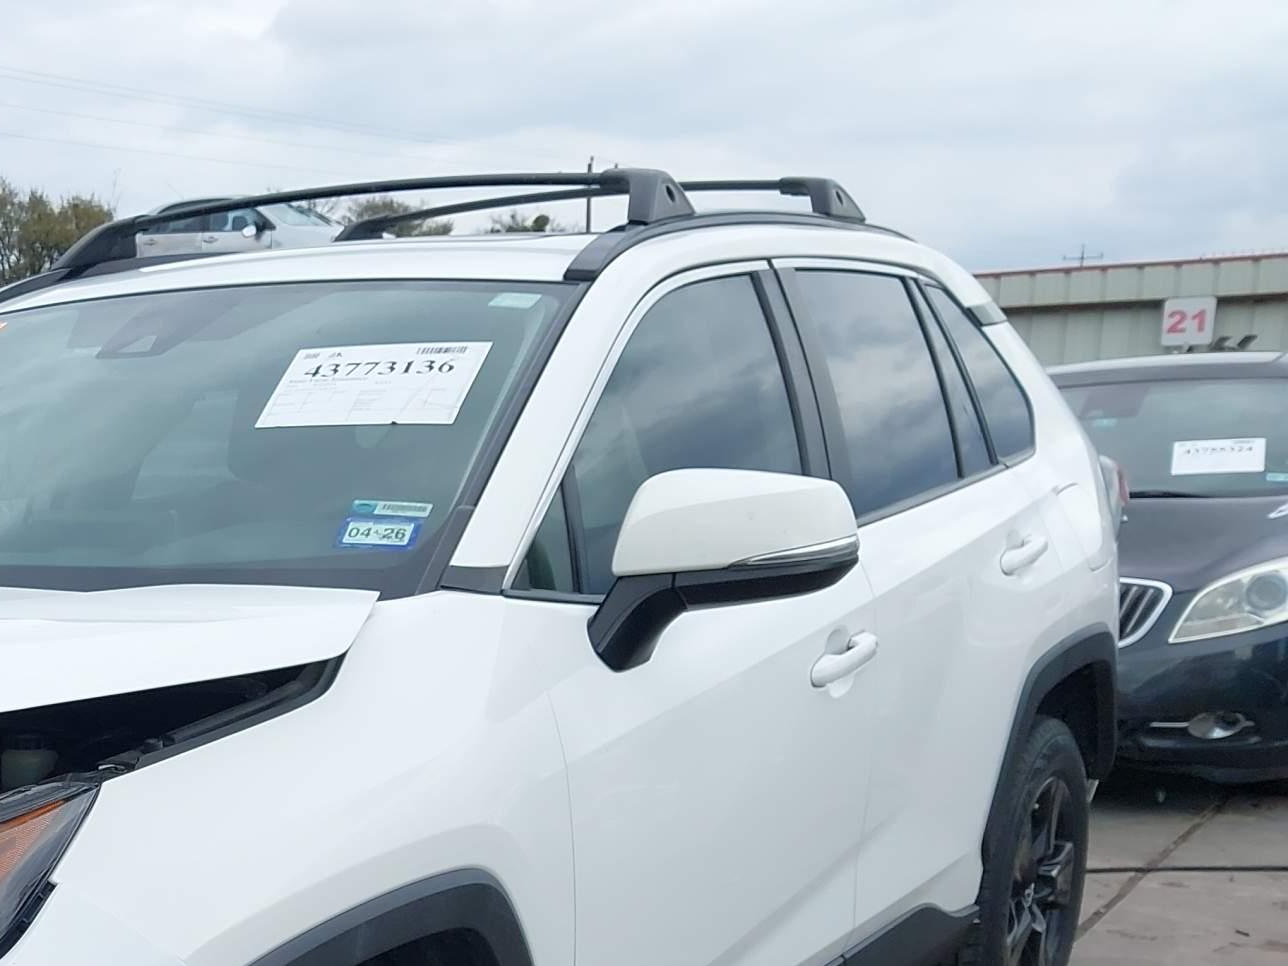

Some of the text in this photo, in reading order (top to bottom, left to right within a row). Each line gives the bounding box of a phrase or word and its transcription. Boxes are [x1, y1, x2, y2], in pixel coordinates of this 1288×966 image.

[1165, 309, 1207, 334] 21
[304, 358, 456, 380] 43773136
[348, 527, 407, 540] 04 26
